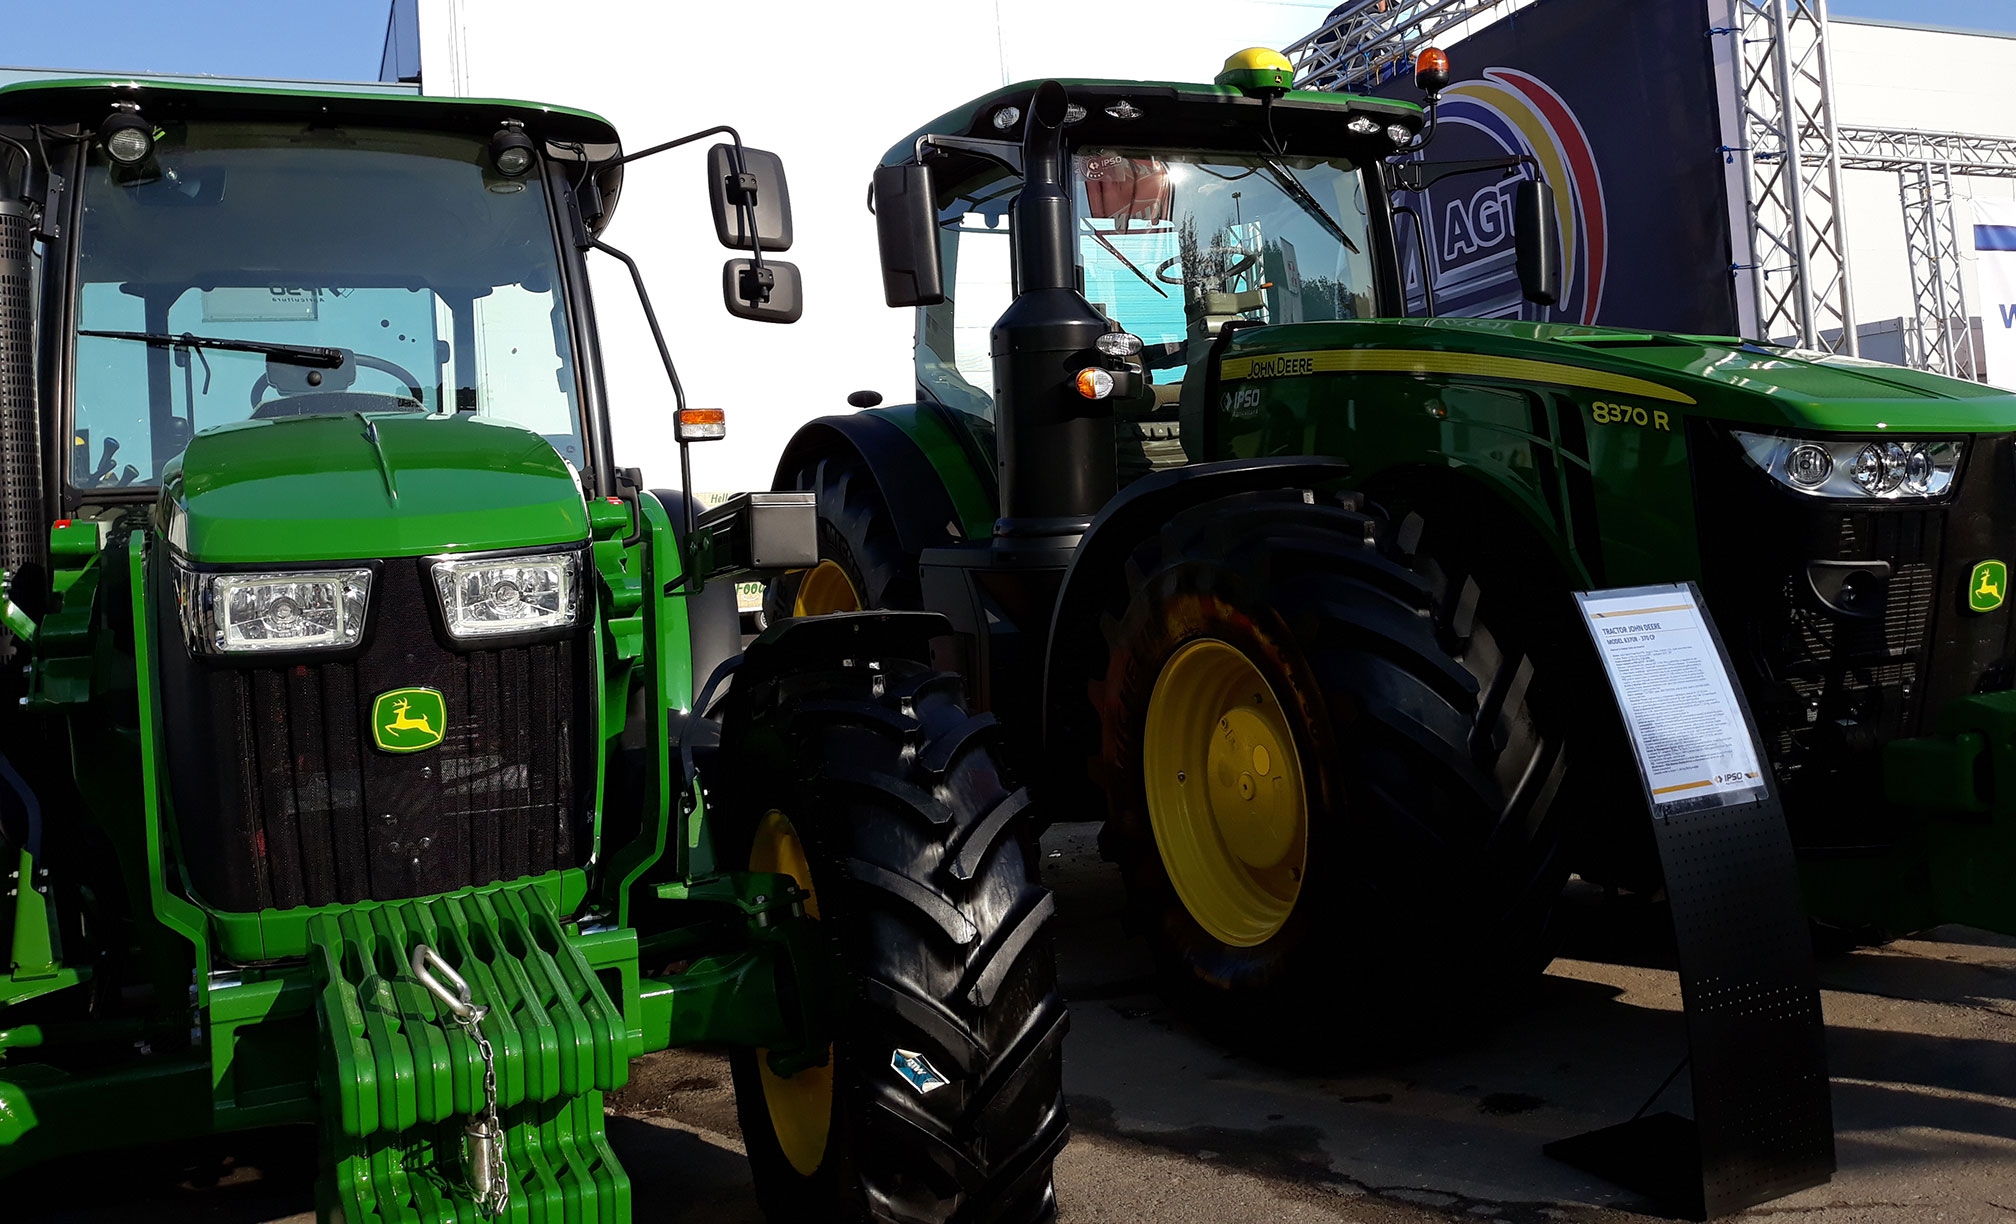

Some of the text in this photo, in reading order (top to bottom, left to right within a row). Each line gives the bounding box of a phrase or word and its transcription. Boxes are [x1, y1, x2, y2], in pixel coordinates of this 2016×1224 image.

[1101, 156, 1122, 167] IPSO
[1247, 357, 1313, 378] JOHN DEERE
[1234, 389, 1260, 409] IPSO
[1592, 401, 1670, 431] 8370 R
[1602, 622, 1662, 635] TRACTOR JOHN DEERE
[1724, 772, 1743, 782] IPSO
